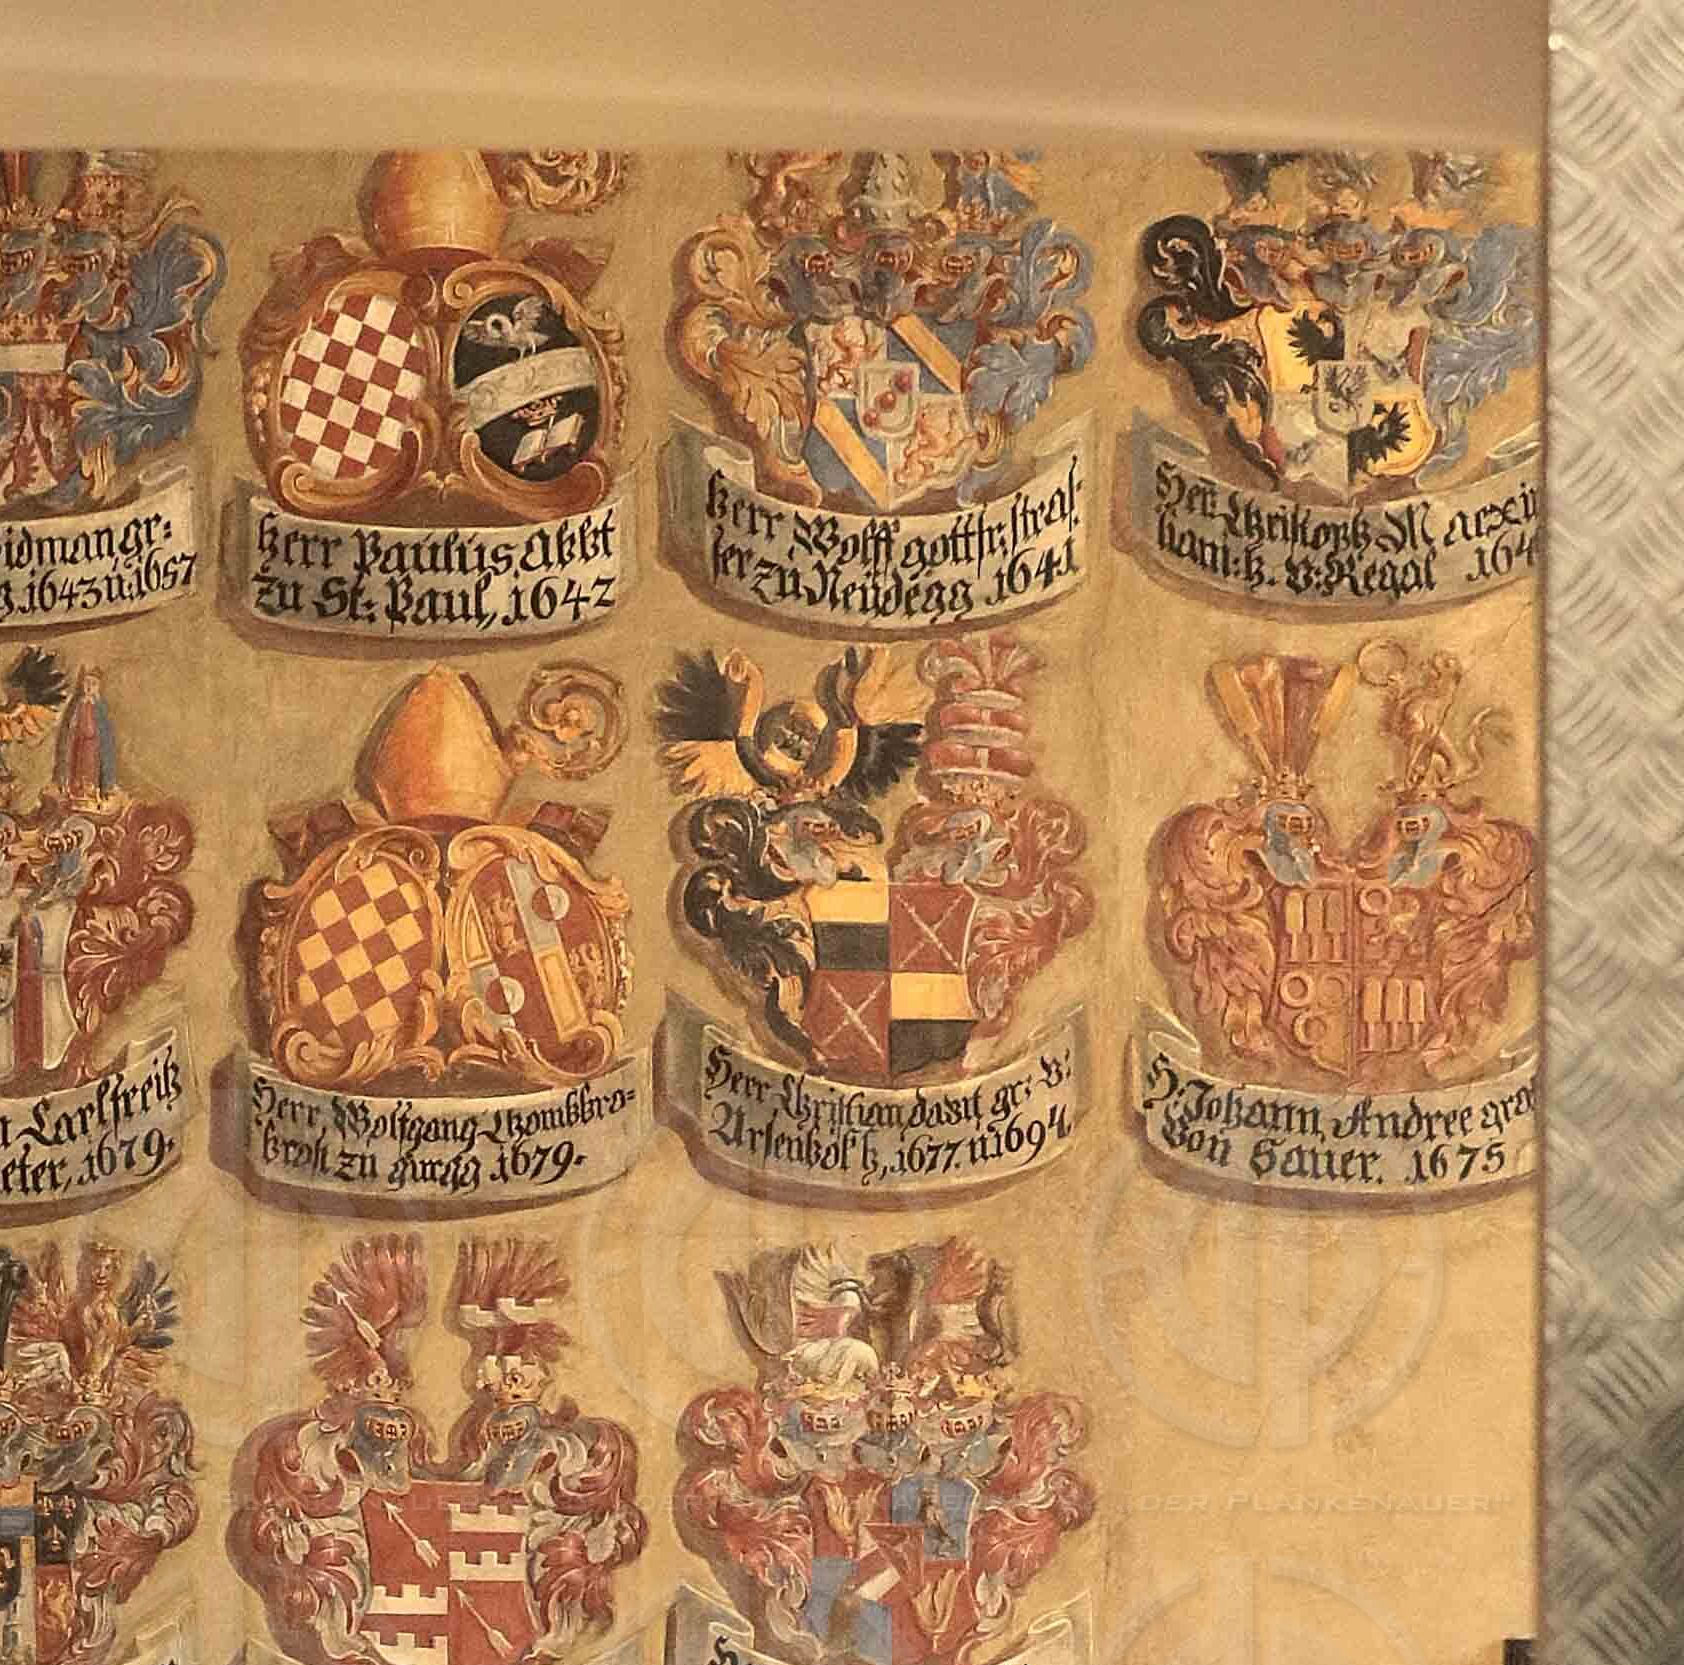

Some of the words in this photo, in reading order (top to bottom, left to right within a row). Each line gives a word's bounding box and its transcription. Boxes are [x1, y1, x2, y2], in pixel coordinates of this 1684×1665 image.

[21, 570, 102, 615] 1643
[985, 539, 1079, 607] 1641
[502, 578, 615, 626] 1642
[1404, 1142, 1506, 1186] 1675
